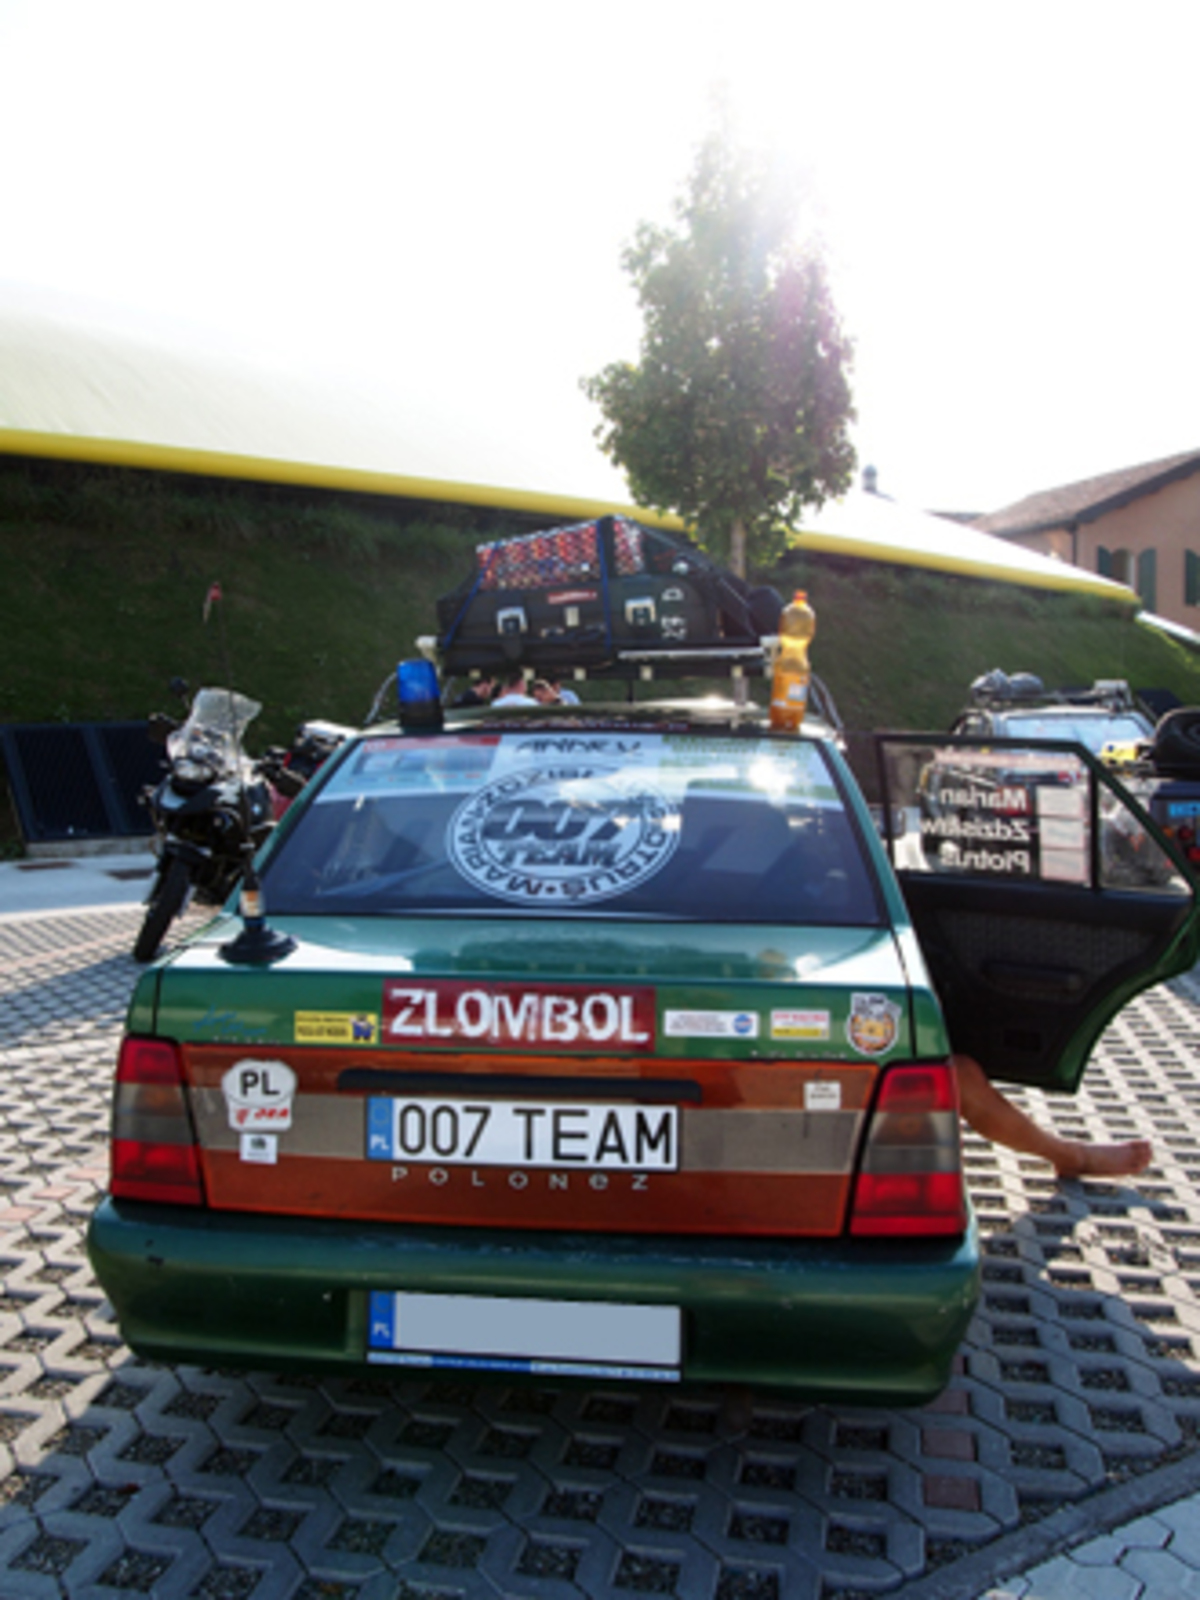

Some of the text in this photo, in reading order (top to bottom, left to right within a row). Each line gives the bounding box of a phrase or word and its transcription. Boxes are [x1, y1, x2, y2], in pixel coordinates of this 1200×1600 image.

[389, 988, 650, 1042] ZLOMBOL
[240, 1071, 280, 1096] PL
[370, 1135, 389, 1150] PL
[399, 1104, 672, 1165] 007 TEAM
[372, 1321, 390, 1338] PL
